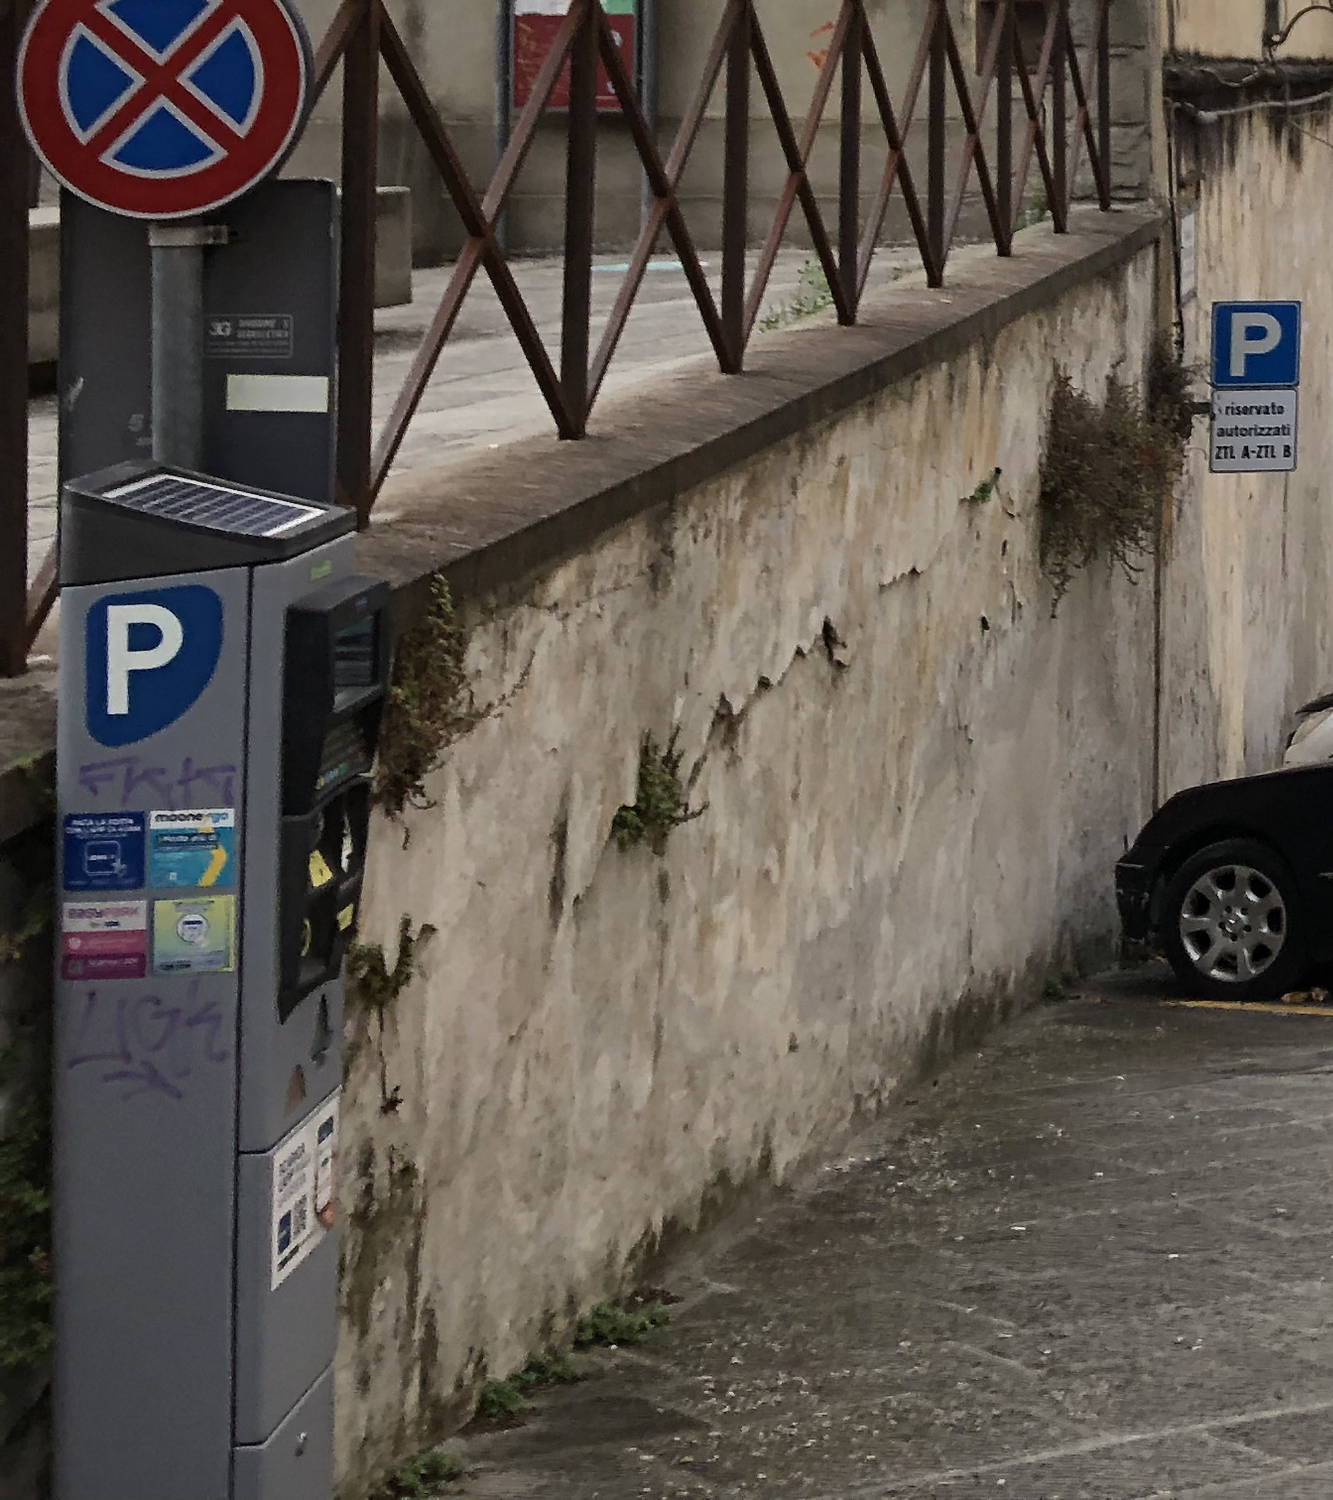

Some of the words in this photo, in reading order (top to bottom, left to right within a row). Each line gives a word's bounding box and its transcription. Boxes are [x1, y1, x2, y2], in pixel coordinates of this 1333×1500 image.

[1229, 311, 1282, 377] P
[1224, 402, 1285, 416] riservato
[1216, 423, 1291, 437] autorizzati
[1214, 445, 1236, 461] ZTL
[1241, 444, 1276, 459] A-ZTL
[1283, 444, 1292, 458] B
[106, 603, 184, 715] P
